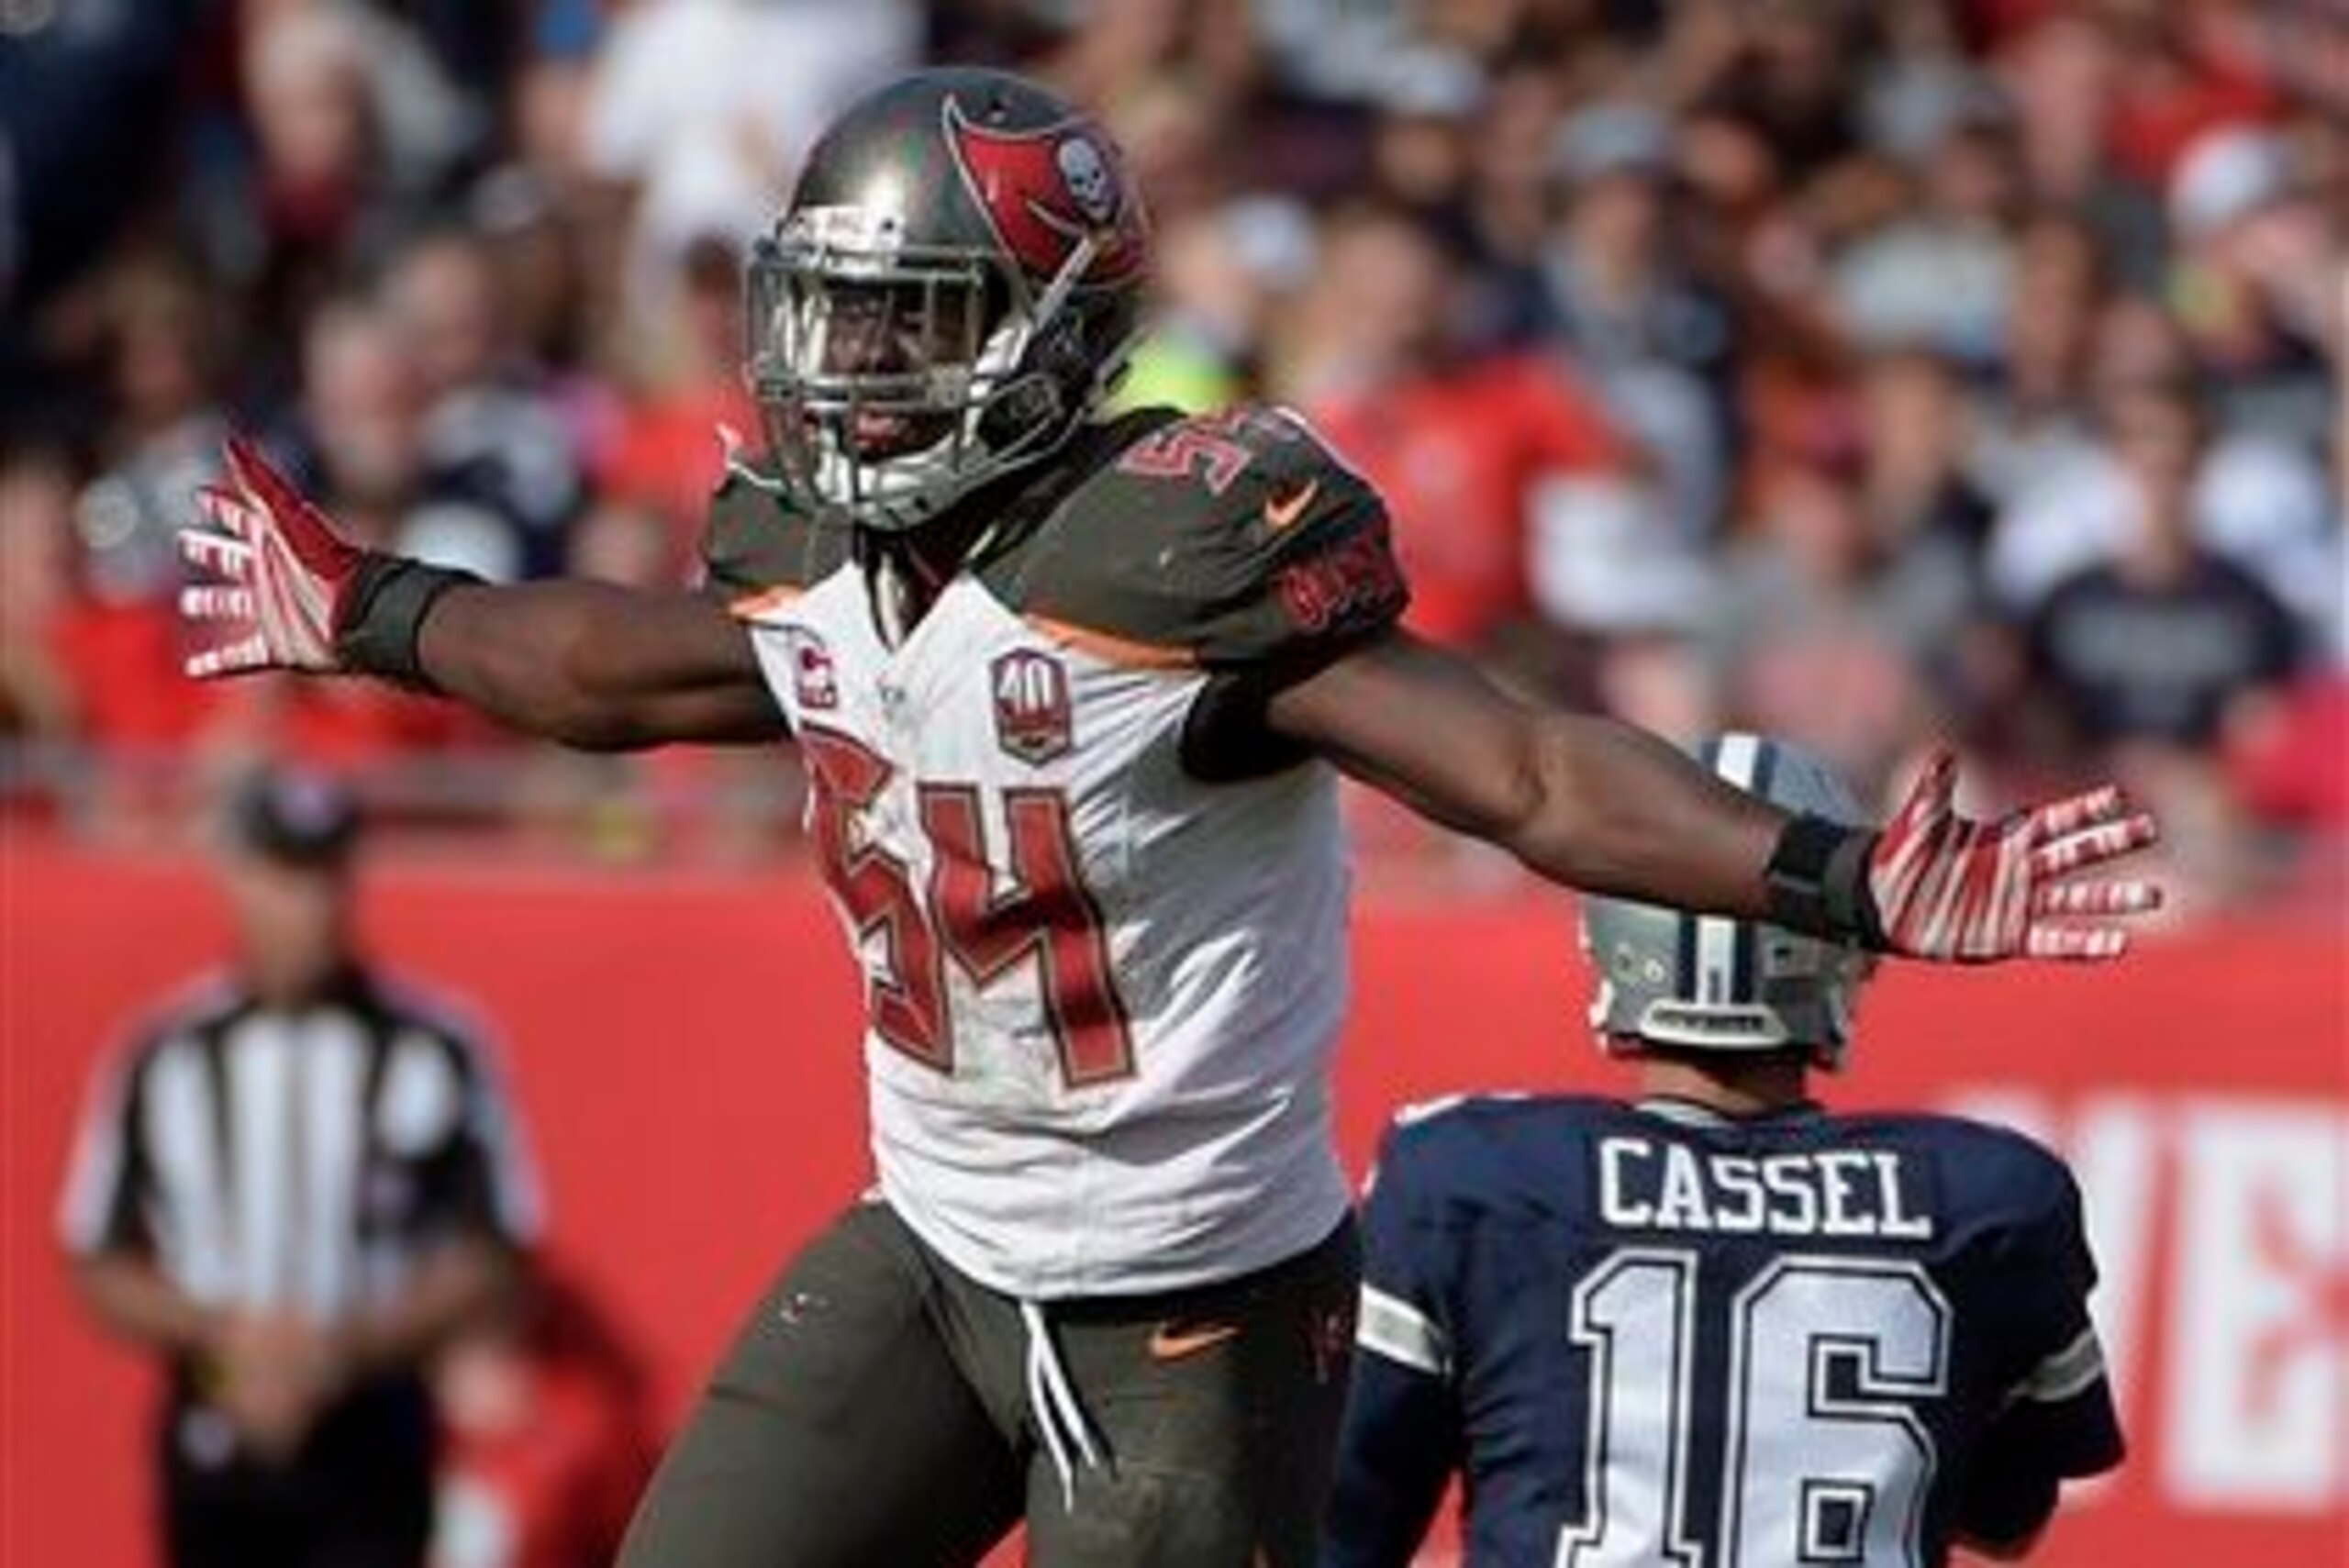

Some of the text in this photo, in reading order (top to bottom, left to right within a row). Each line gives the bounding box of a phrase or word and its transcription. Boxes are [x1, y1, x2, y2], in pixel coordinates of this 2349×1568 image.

[996, 659, 1052, 715] 40
[795, 721, 1139, 1090] 54
[1599, 1138, 1934, 1239] CASSEL
[1557, 1248, 1954, 1568] 16
